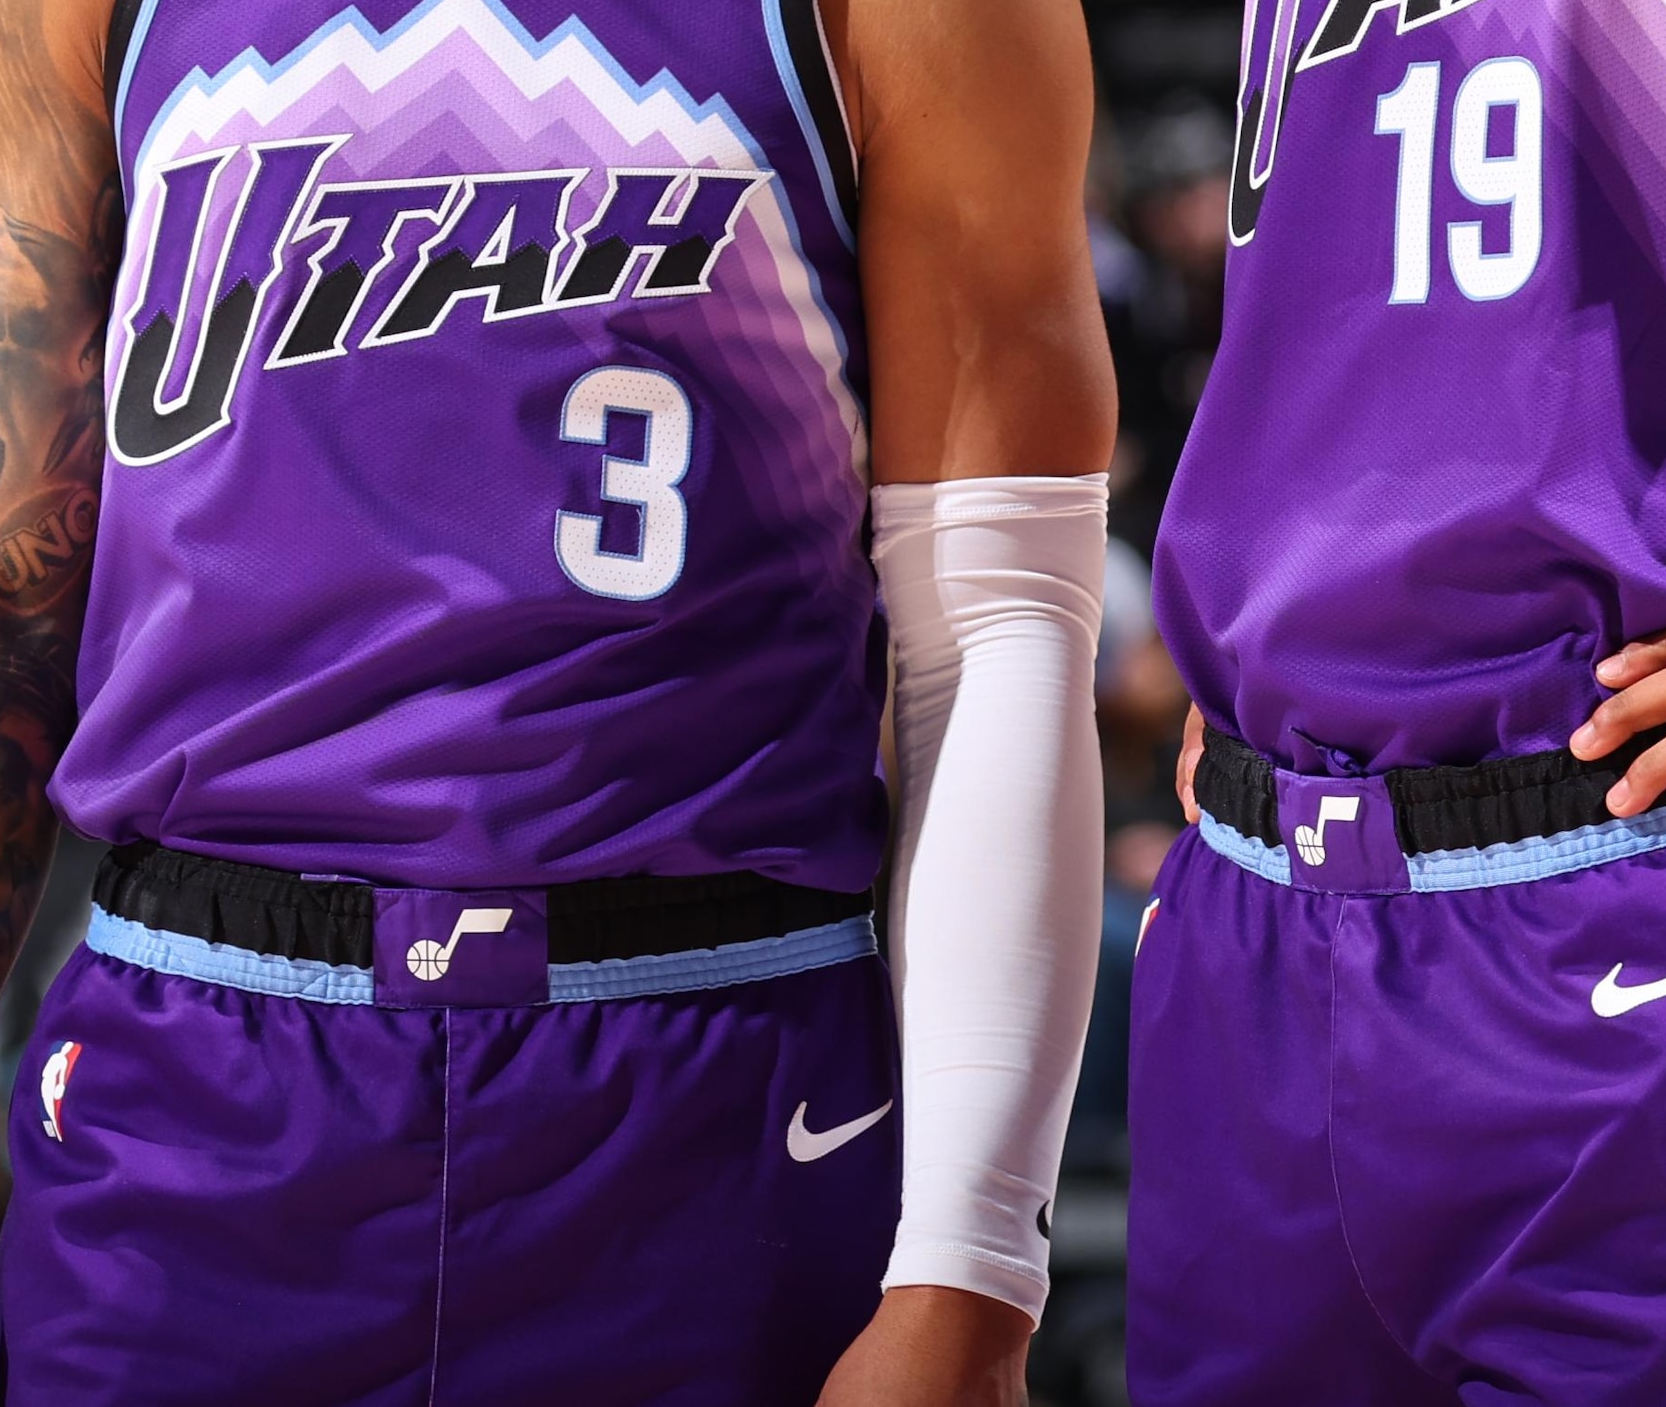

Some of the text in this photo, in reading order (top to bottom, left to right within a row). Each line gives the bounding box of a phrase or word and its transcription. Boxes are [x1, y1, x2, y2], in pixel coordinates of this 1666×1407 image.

[106, 133, 776, 466] UTAH
[1373, 54, 1543, 304] 19
[555, 366, 691, 600] 3
